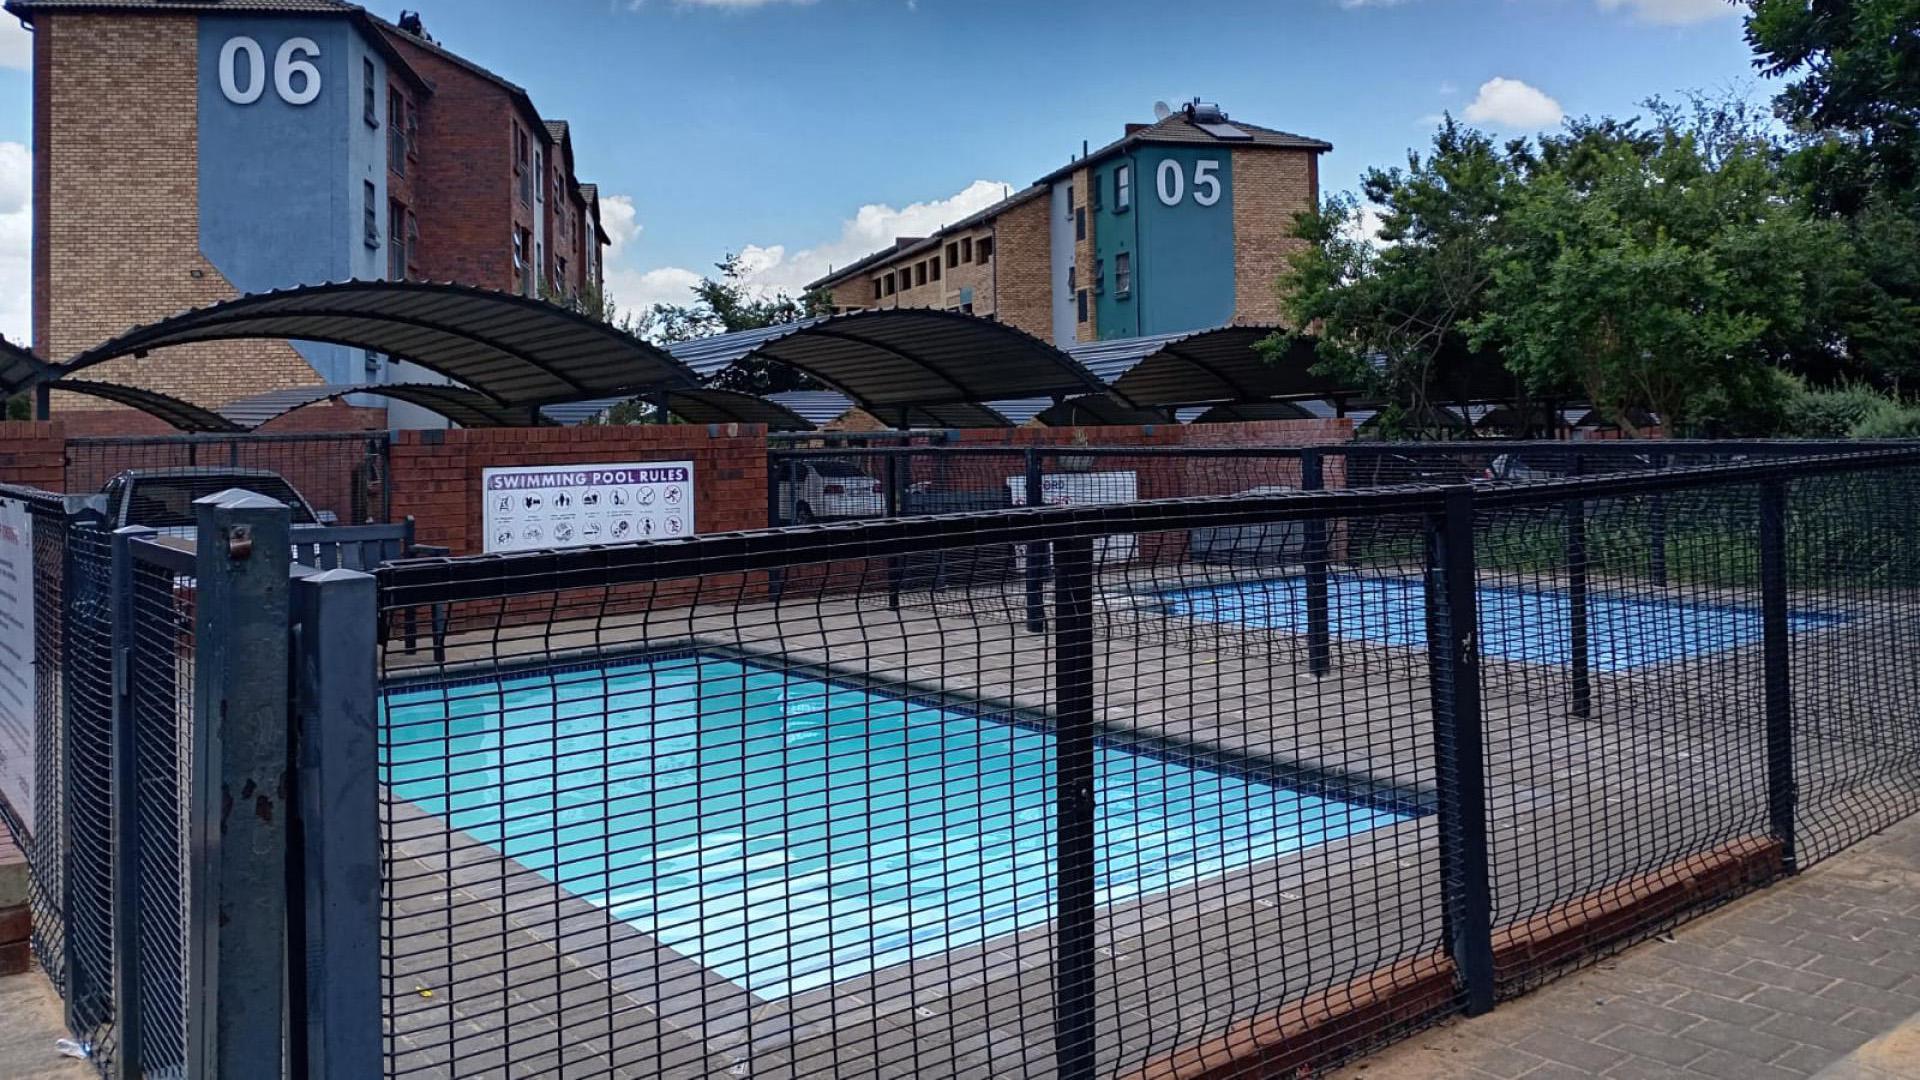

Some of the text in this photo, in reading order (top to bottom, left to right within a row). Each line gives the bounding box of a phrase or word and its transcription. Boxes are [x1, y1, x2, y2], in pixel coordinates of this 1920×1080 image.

[219, 36, 321, 105] 06
[1156, 159, 1221, 207] 05
[494, 467, 684, 489] SWIMMING POOL RULES
